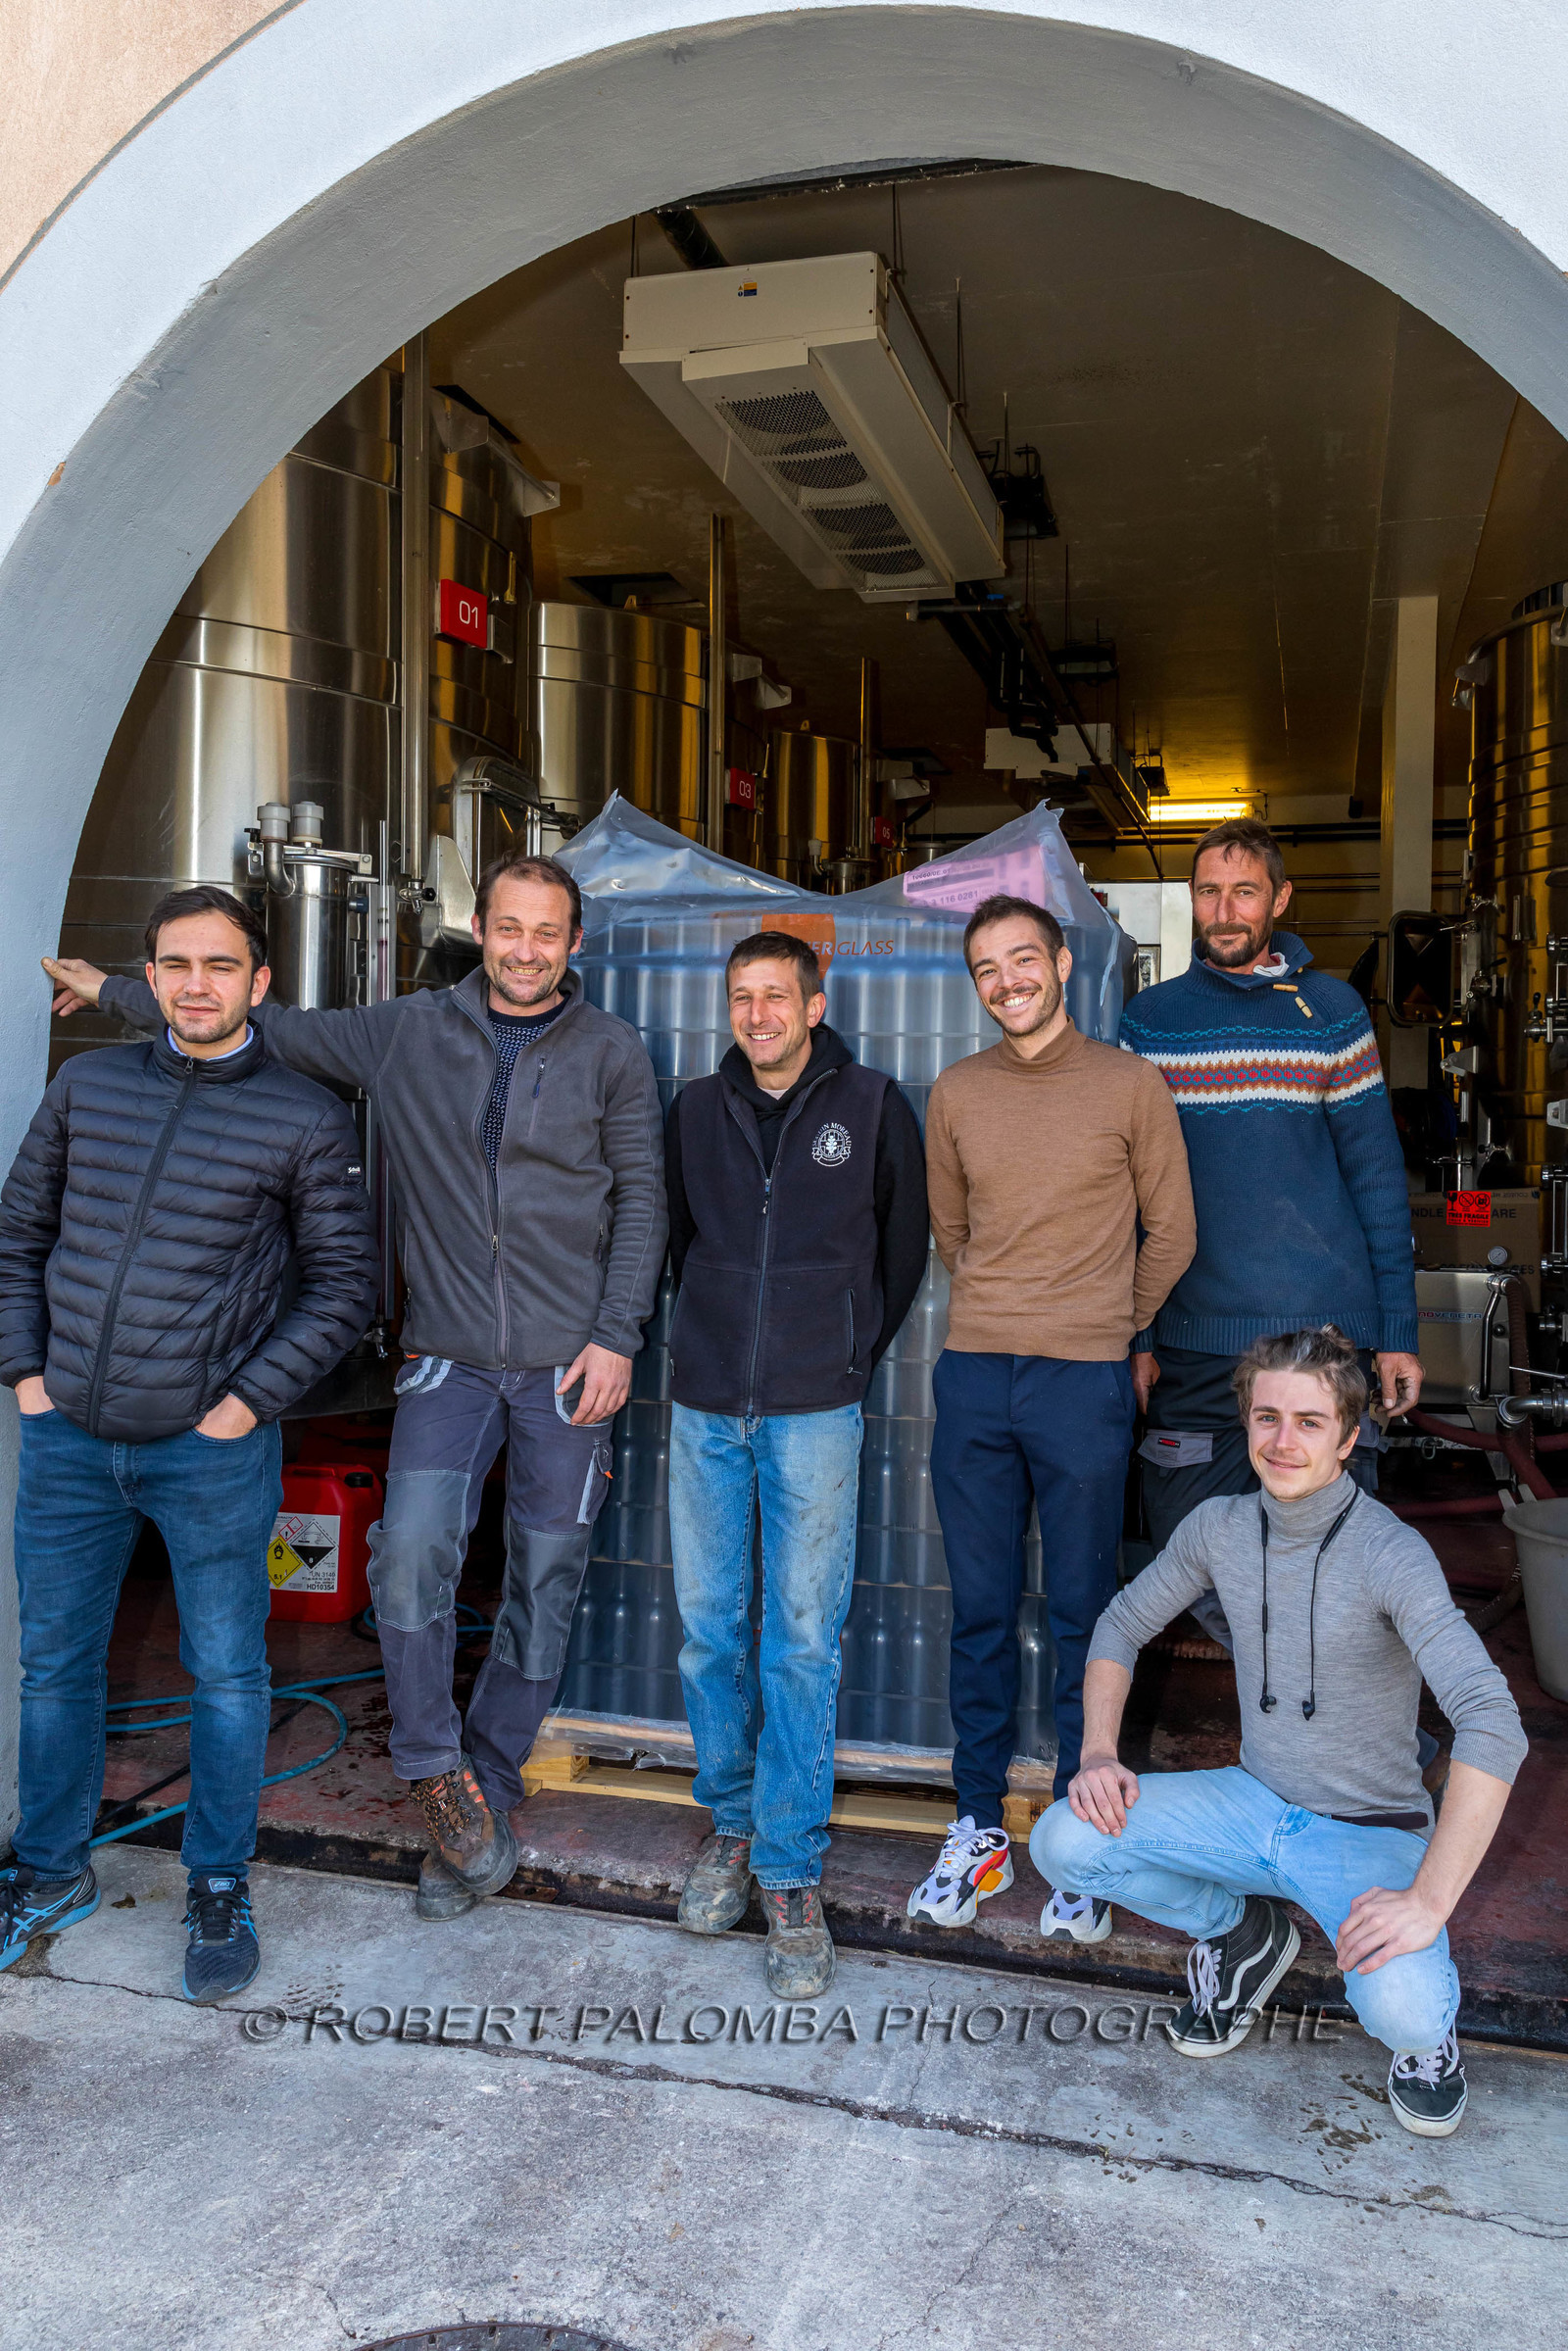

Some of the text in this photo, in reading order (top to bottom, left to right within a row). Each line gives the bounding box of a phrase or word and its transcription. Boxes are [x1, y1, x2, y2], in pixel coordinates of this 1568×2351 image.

[460, 600, 478, 629] 01
[739, 780, 752, 799] 03
[882, 827, 890, 840] 05
[808, 940, 894, 955] ERGLASS
[830, 1122, 852, 1147] MOREAU
[1411, 1207, 1444, 1218] NDLE
[1492, 1208, 1517, 1219] ARE
